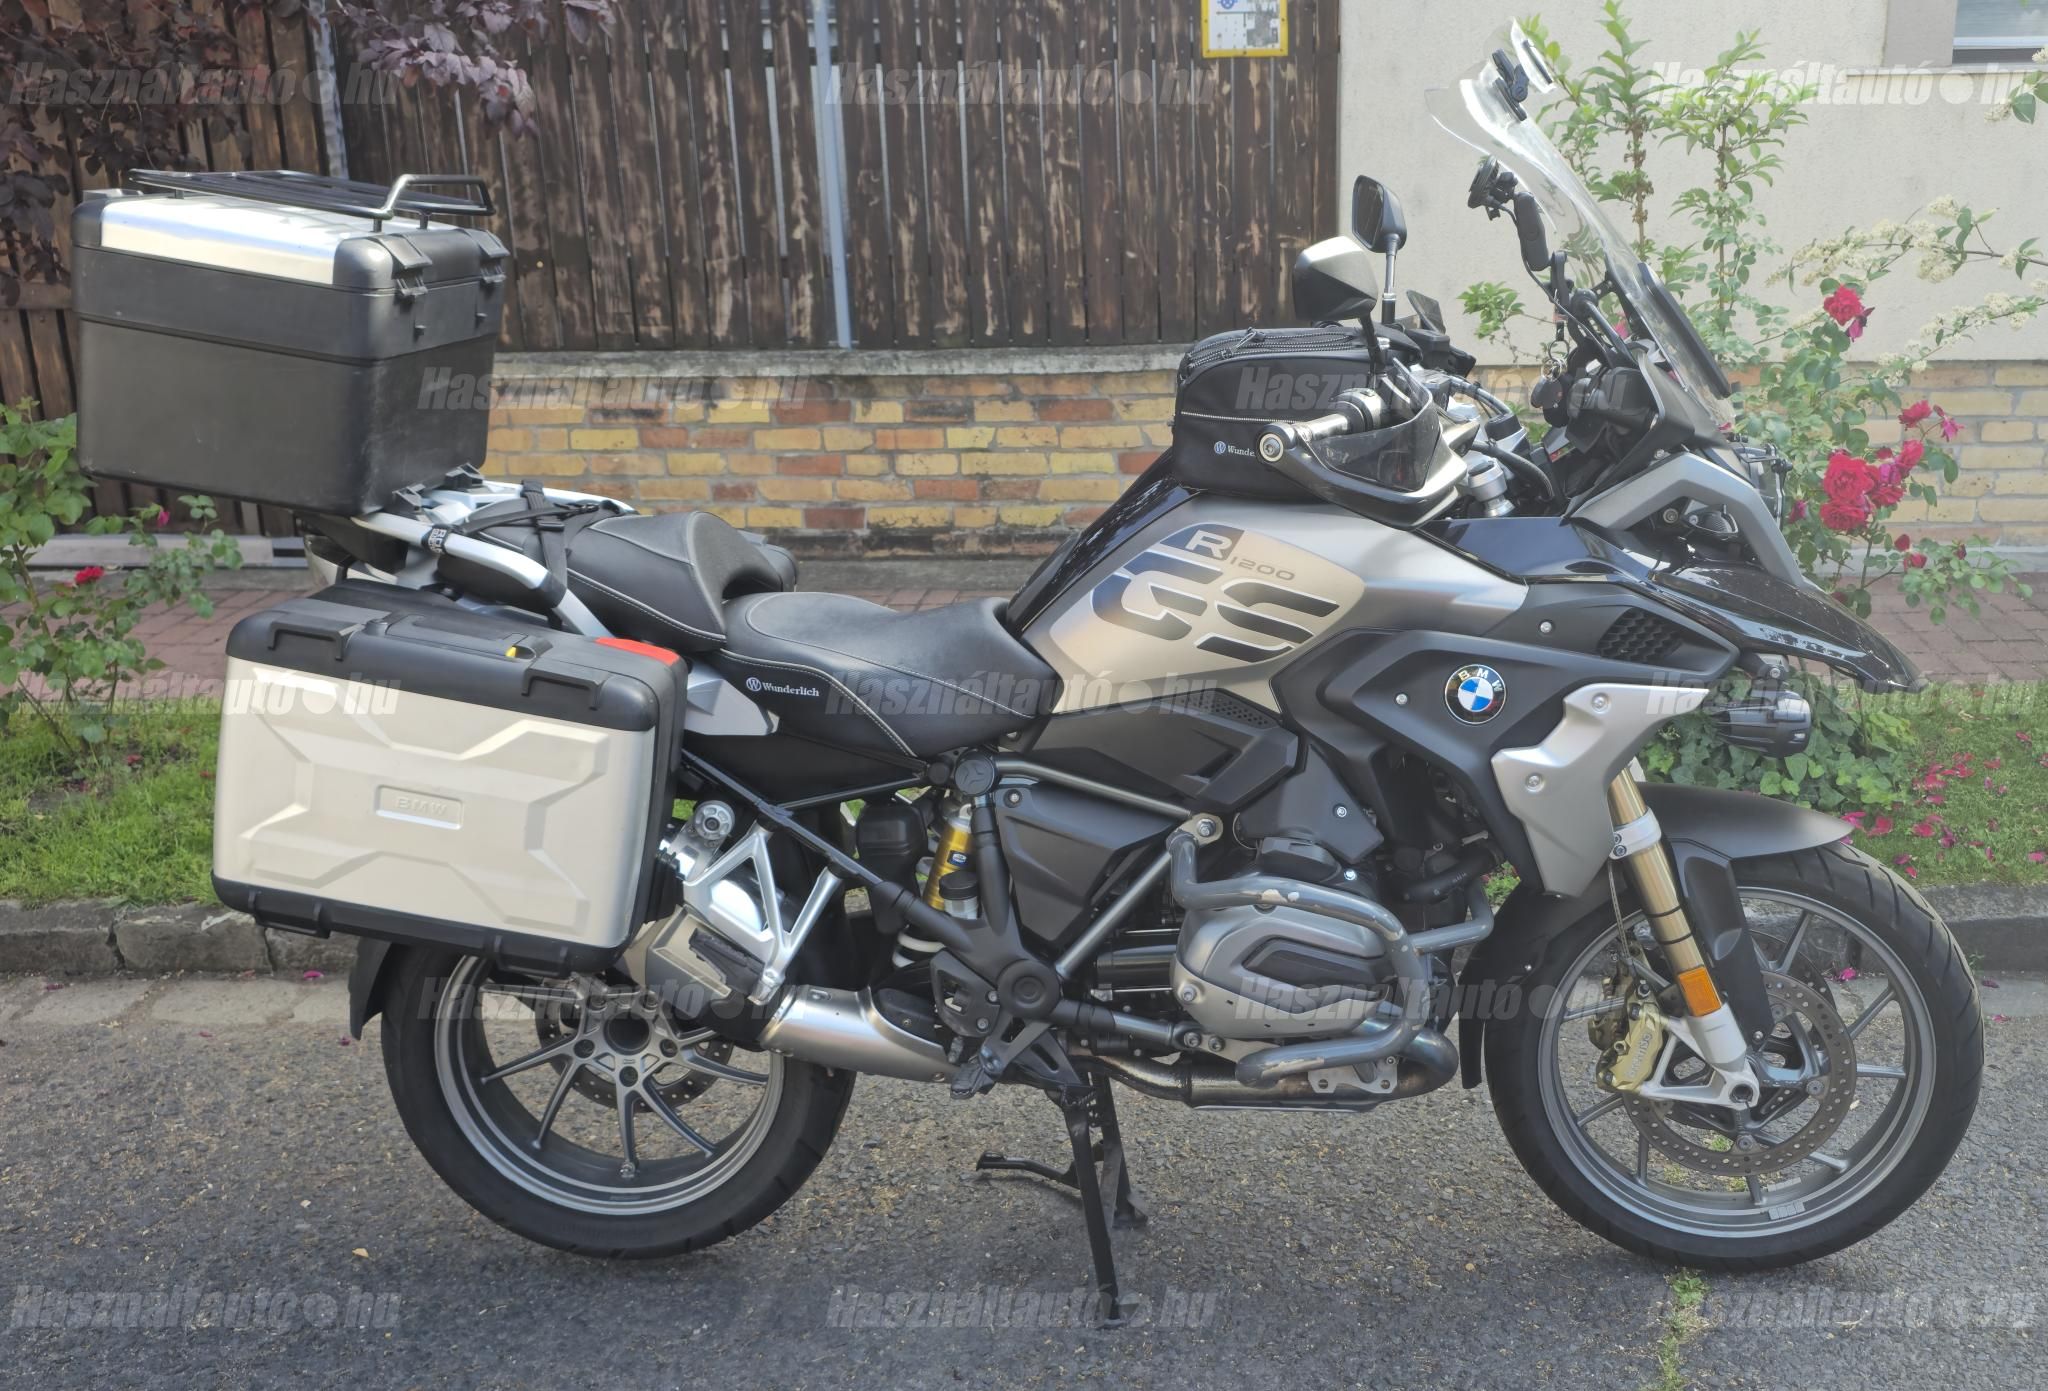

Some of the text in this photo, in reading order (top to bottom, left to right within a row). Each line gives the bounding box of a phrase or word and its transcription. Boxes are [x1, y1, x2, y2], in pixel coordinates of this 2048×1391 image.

[1227, 445, 1256, 457] Wunde
[1185, 529, 1296, 581] R 1200
[1091, 547, 1341, 664] GS
[762, 682, 820, 697] Wunderlich
[1458, 667, 1504, 692] BMW
[395, 795, 448, 816] BMW
